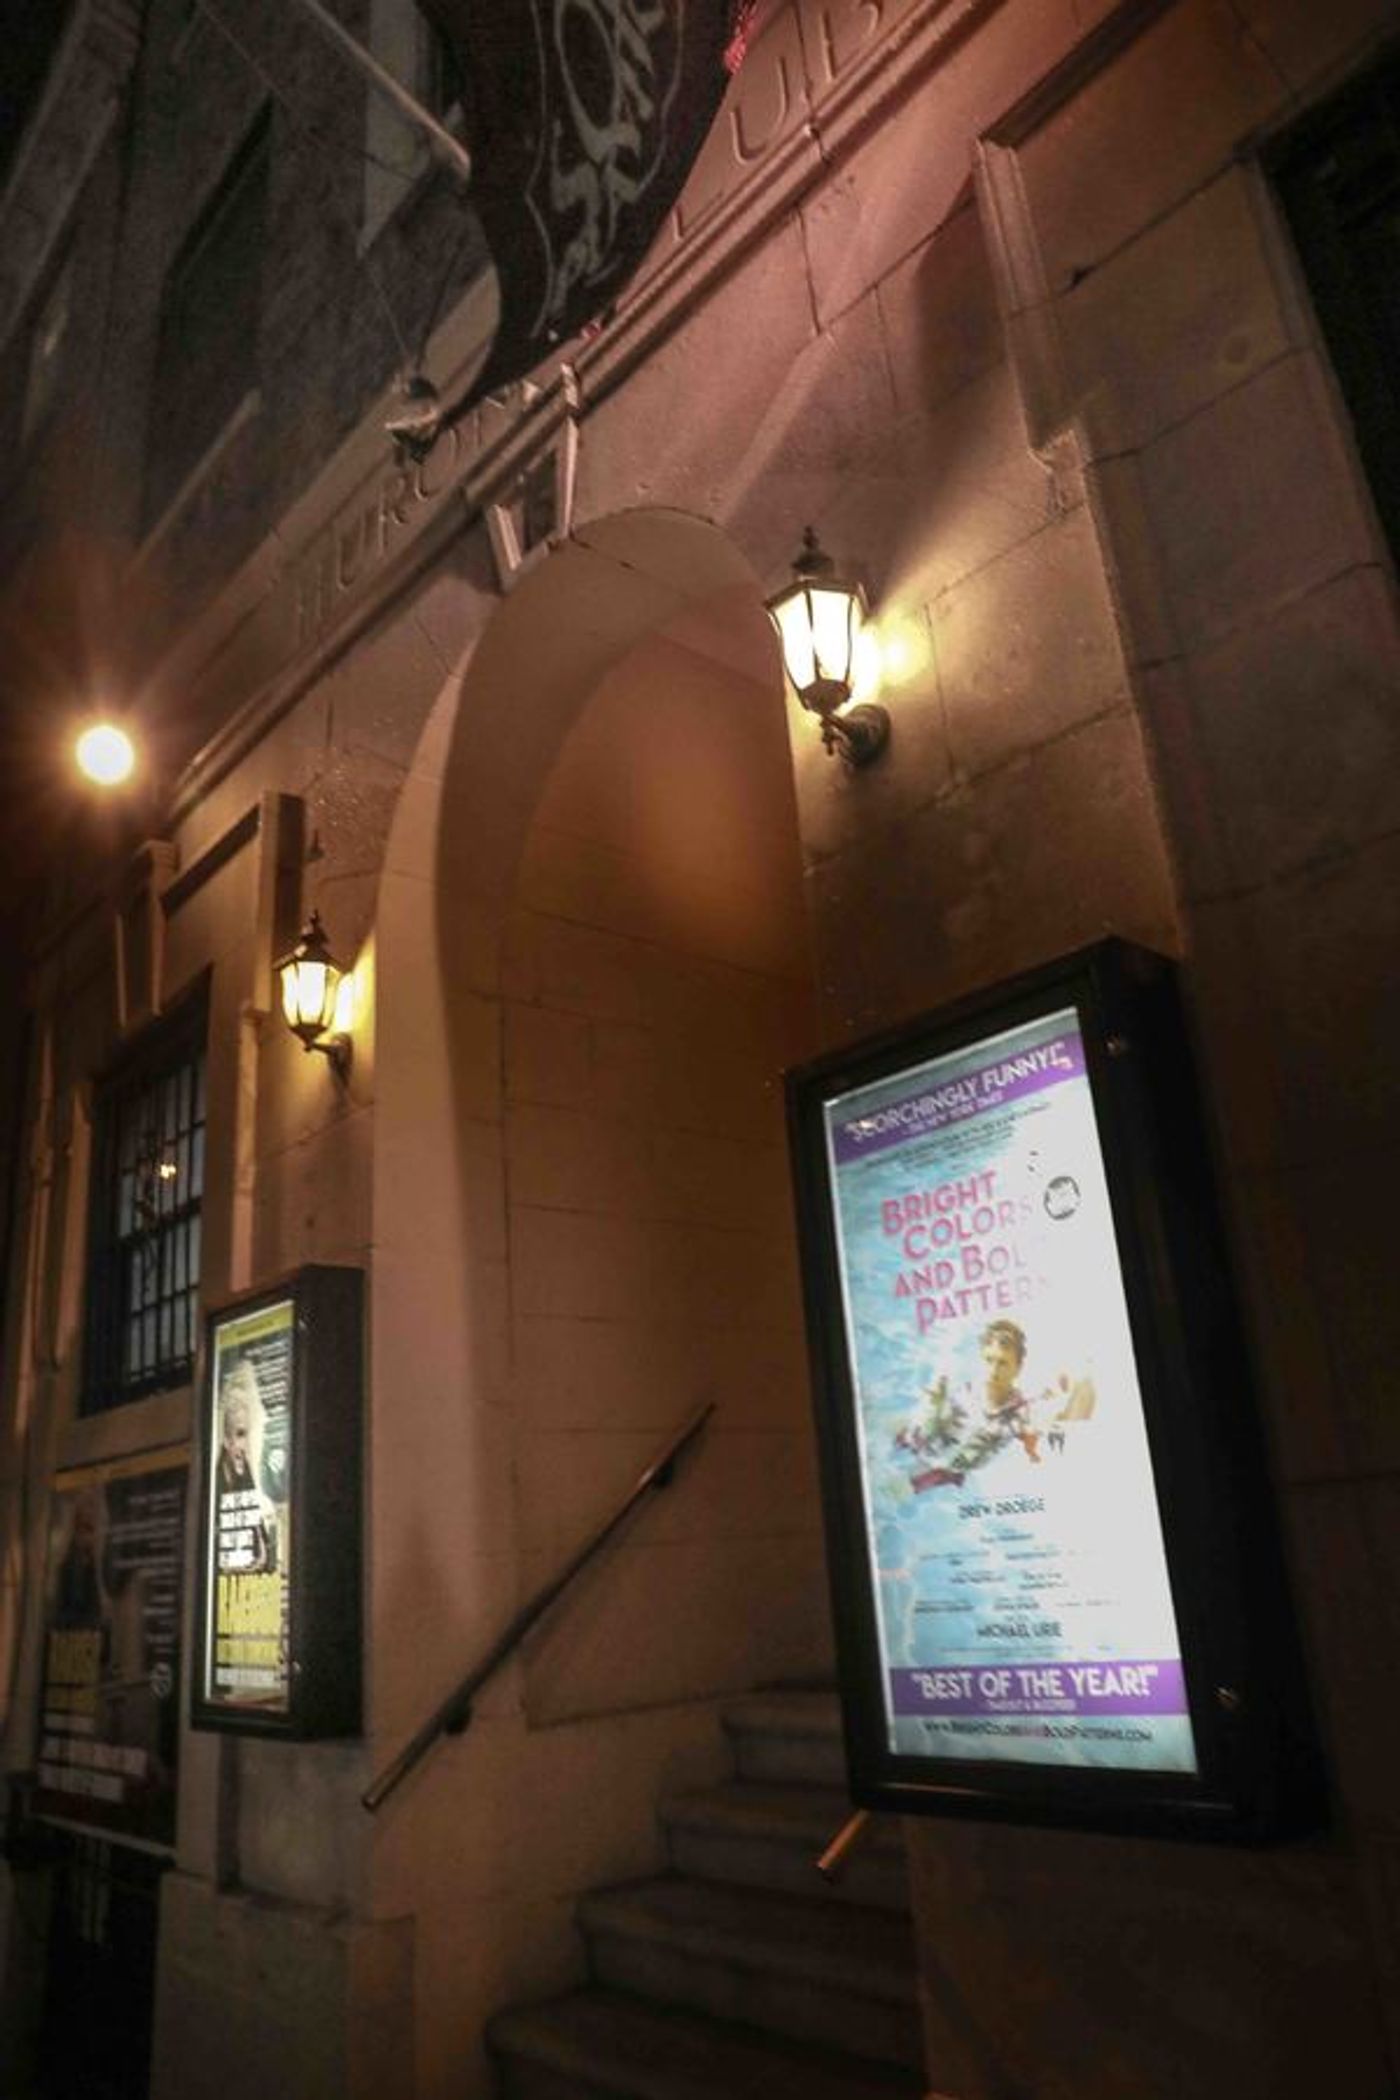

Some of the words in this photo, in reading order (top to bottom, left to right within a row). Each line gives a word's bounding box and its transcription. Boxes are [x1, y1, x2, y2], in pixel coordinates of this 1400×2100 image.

[880, 1171, 997, 1237] BRIGHT
[895, 1260, 955, 1298] AND
[960, 1241, 1029, 1283] BOL
[915, 1270, 1046, 1336] PATTER
[911, 1670, 973, 1699] "BEST
[978, 1670, 1012, 1698] OF
[1015, 1668, 1065, 1698] THE
